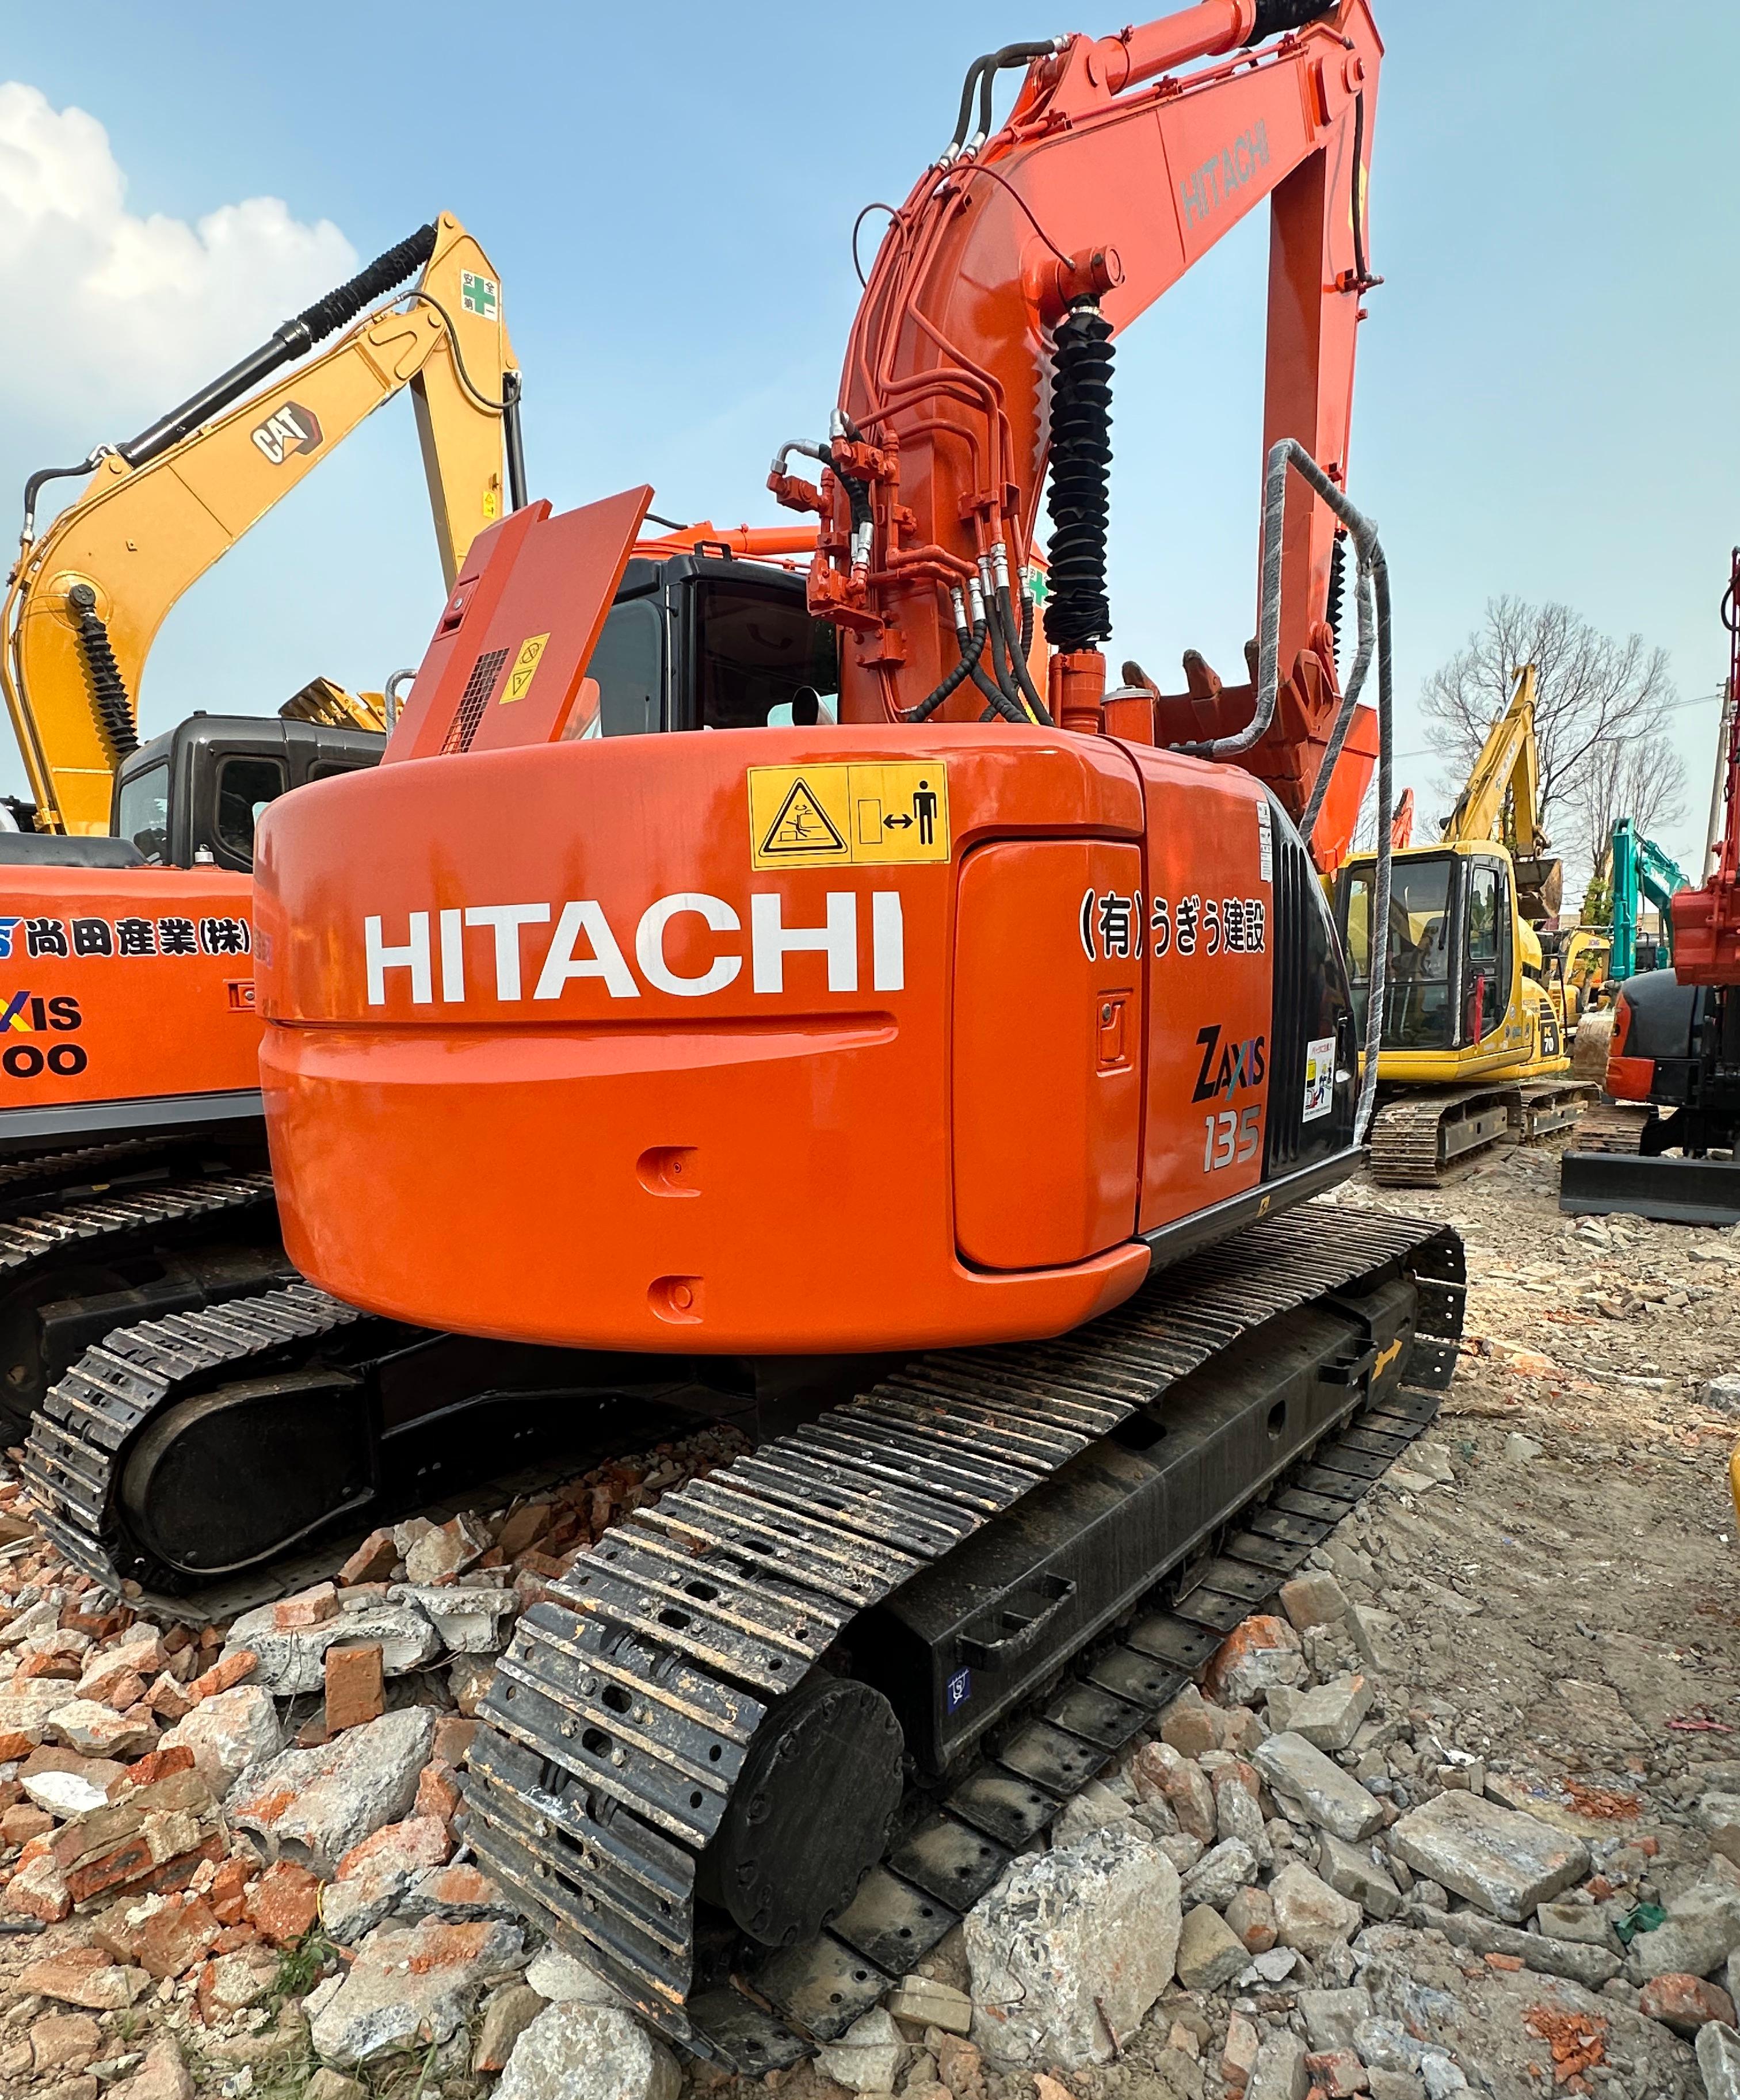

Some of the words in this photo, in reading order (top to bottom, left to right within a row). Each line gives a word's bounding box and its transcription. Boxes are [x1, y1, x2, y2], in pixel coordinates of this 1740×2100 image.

[1180, 118, 1270, 230] HITACHI
[253, 406, 308, 463] CAT
[25, 917, 251, 957] 尚田産業(株)
[365, 891, 904, 1006] HITACHI
[1191, 1024, 1265, 1103] ZAXIS
[1544, 1037, 1554, 1053] 70
[1203, 1104, 1261, 1174] 135
